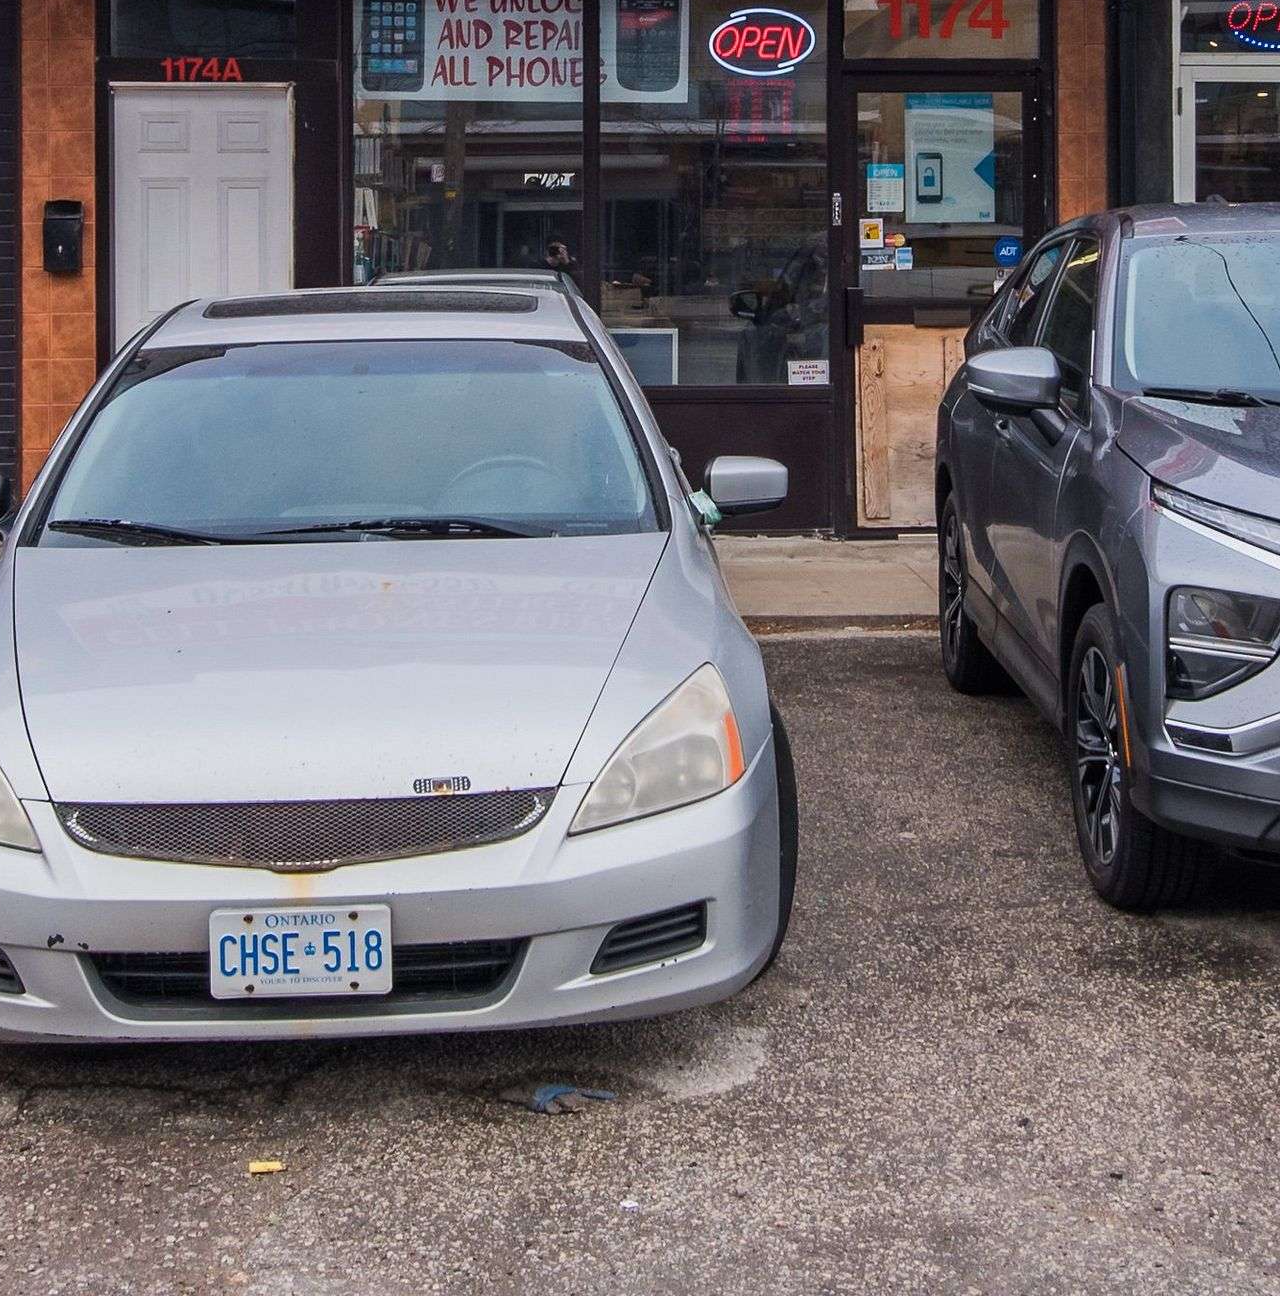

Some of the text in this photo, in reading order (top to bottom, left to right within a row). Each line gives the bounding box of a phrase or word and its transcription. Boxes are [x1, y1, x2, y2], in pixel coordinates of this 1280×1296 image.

[437, 18, 583, 51] AND REPAI
[715, 25, 806, 59] OPEN
[161, 56, 243, 81] 1174A
[431, 54, 477, 87] ALL
[999, 246, 1018, 257] ADT
[265, 913, 335, 929] ONTARIO
[219, 930, 383, 977] CHSE 518
